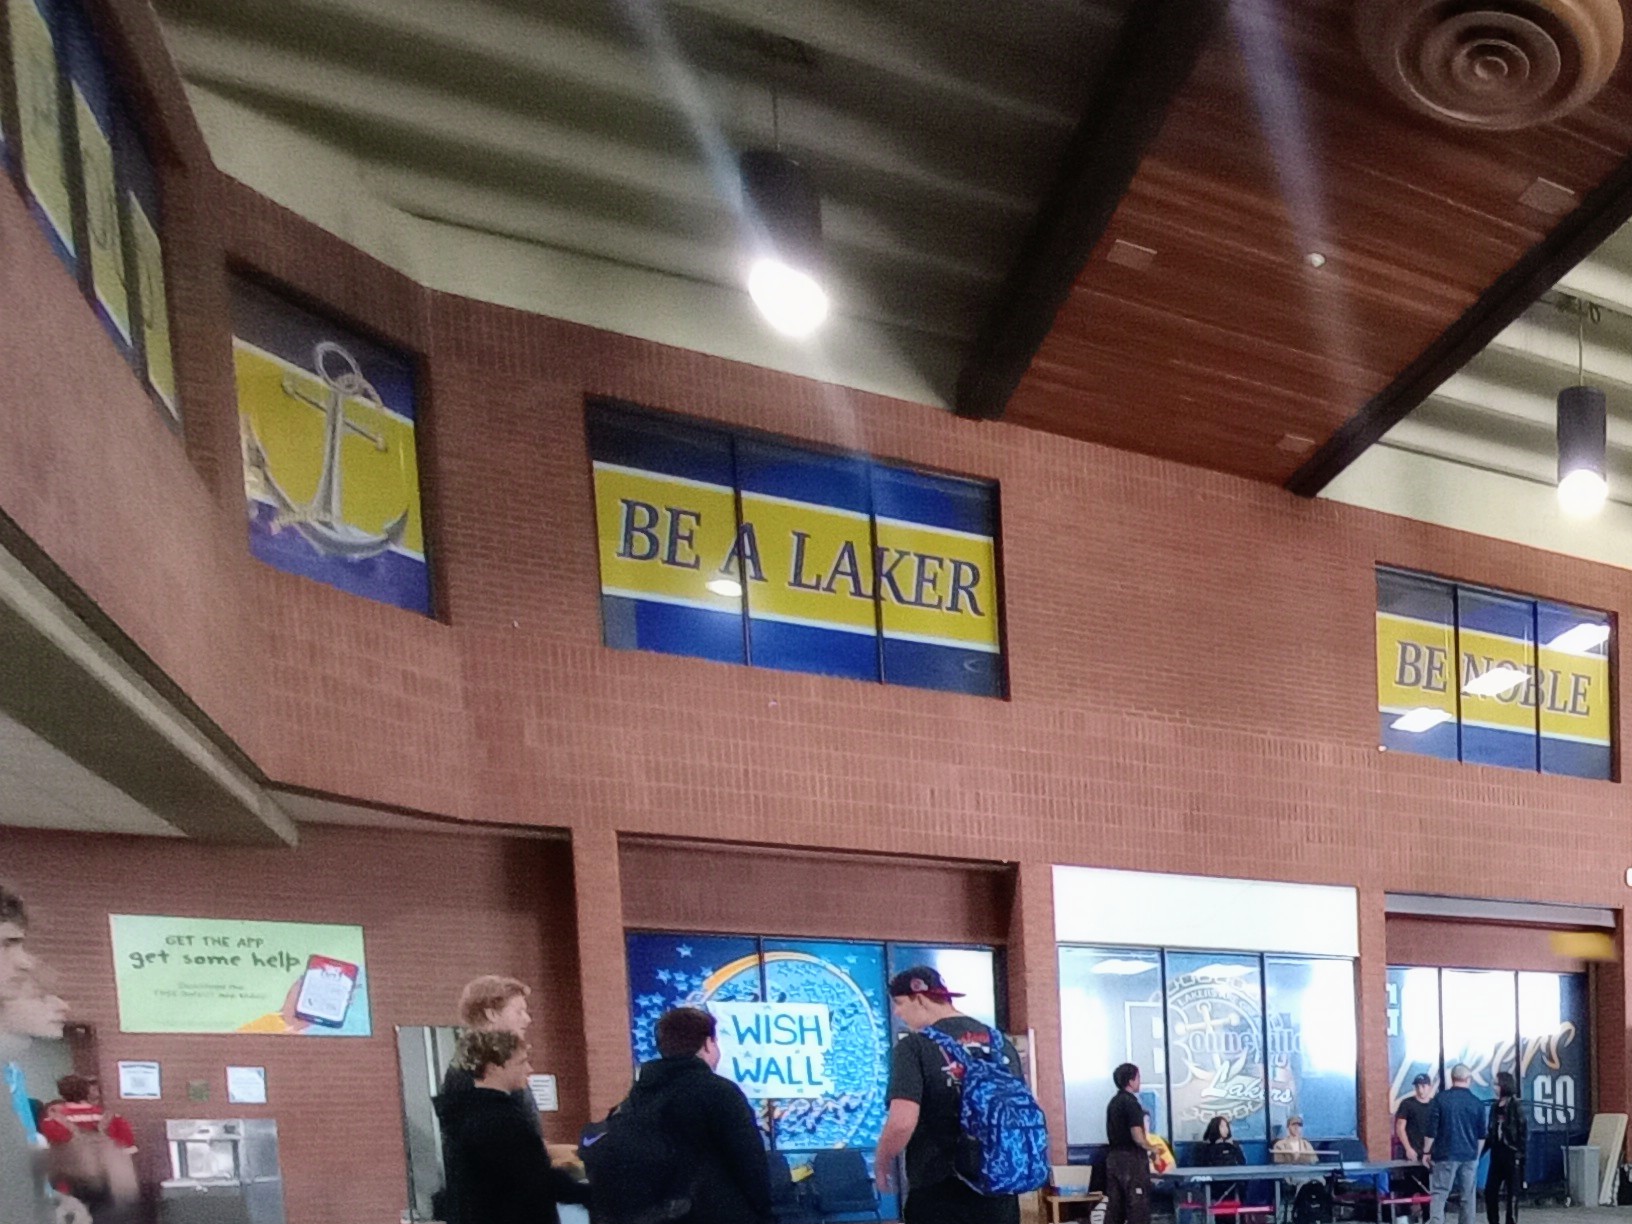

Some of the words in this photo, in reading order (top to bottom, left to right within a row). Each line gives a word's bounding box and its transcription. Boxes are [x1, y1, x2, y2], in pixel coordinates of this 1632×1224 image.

[616, 498, 701, 570] BE
[718, 522, 768, 583] A
[787, 530, 986, 617] LAKER
[1394, 640, 1448, 693] BE
[1460, 652, 1592, 717] NOBLE
[165, 935, 195, 946] GET
[202, 936, 230, 947] THE
[237, 937, 264, 949] APP
[129, 950, 169, 970] get
[183, 953, 242, 966] some
[252, 950, 300, 973] help
[732, 1013, 824, 1047] WISH
[732, 1055, 824, 1086] WALL
[1533, 1074, 1576, 1124] GO
